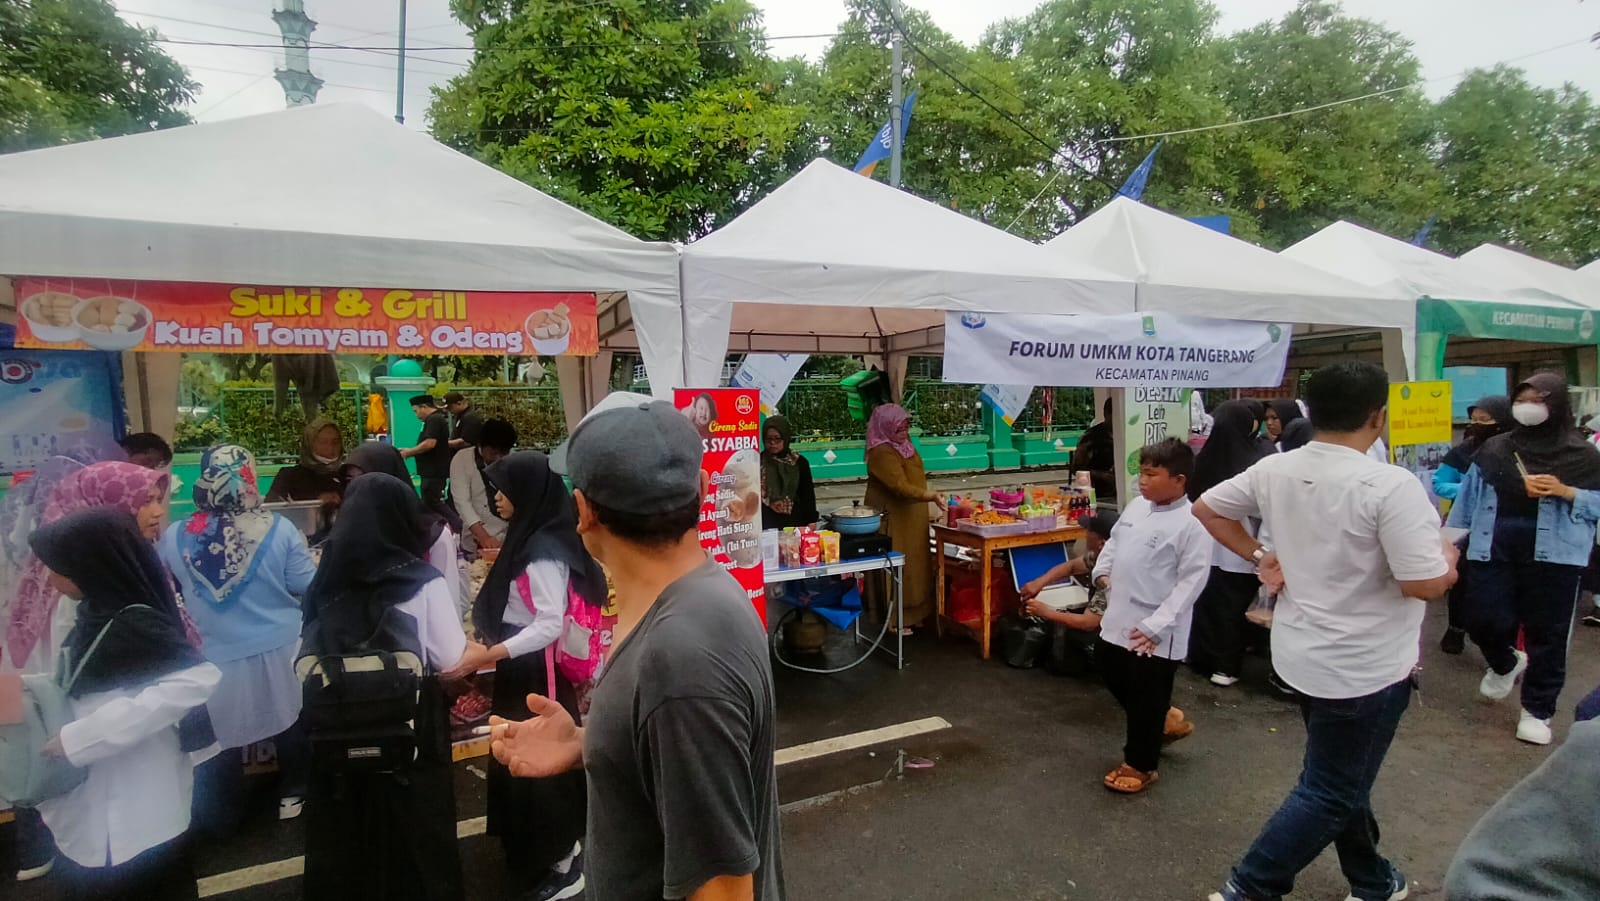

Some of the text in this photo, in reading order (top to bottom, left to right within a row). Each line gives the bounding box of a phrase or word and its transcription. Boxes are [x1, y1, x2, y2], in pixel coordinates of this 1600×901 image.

[229, 287, 467, 320] Suki & Grill
[154, 320, 524, 354] Kuah Tomyam & Odeng
[1008, 340, 1256, 364] FORUM UMKM KOTA TANGERANG
[1095, 367, 1209, 382] KECAMATAN PINANG
[708, 420, 737, 434] Cireng
[711, 435, 759, 453] SYABBA
